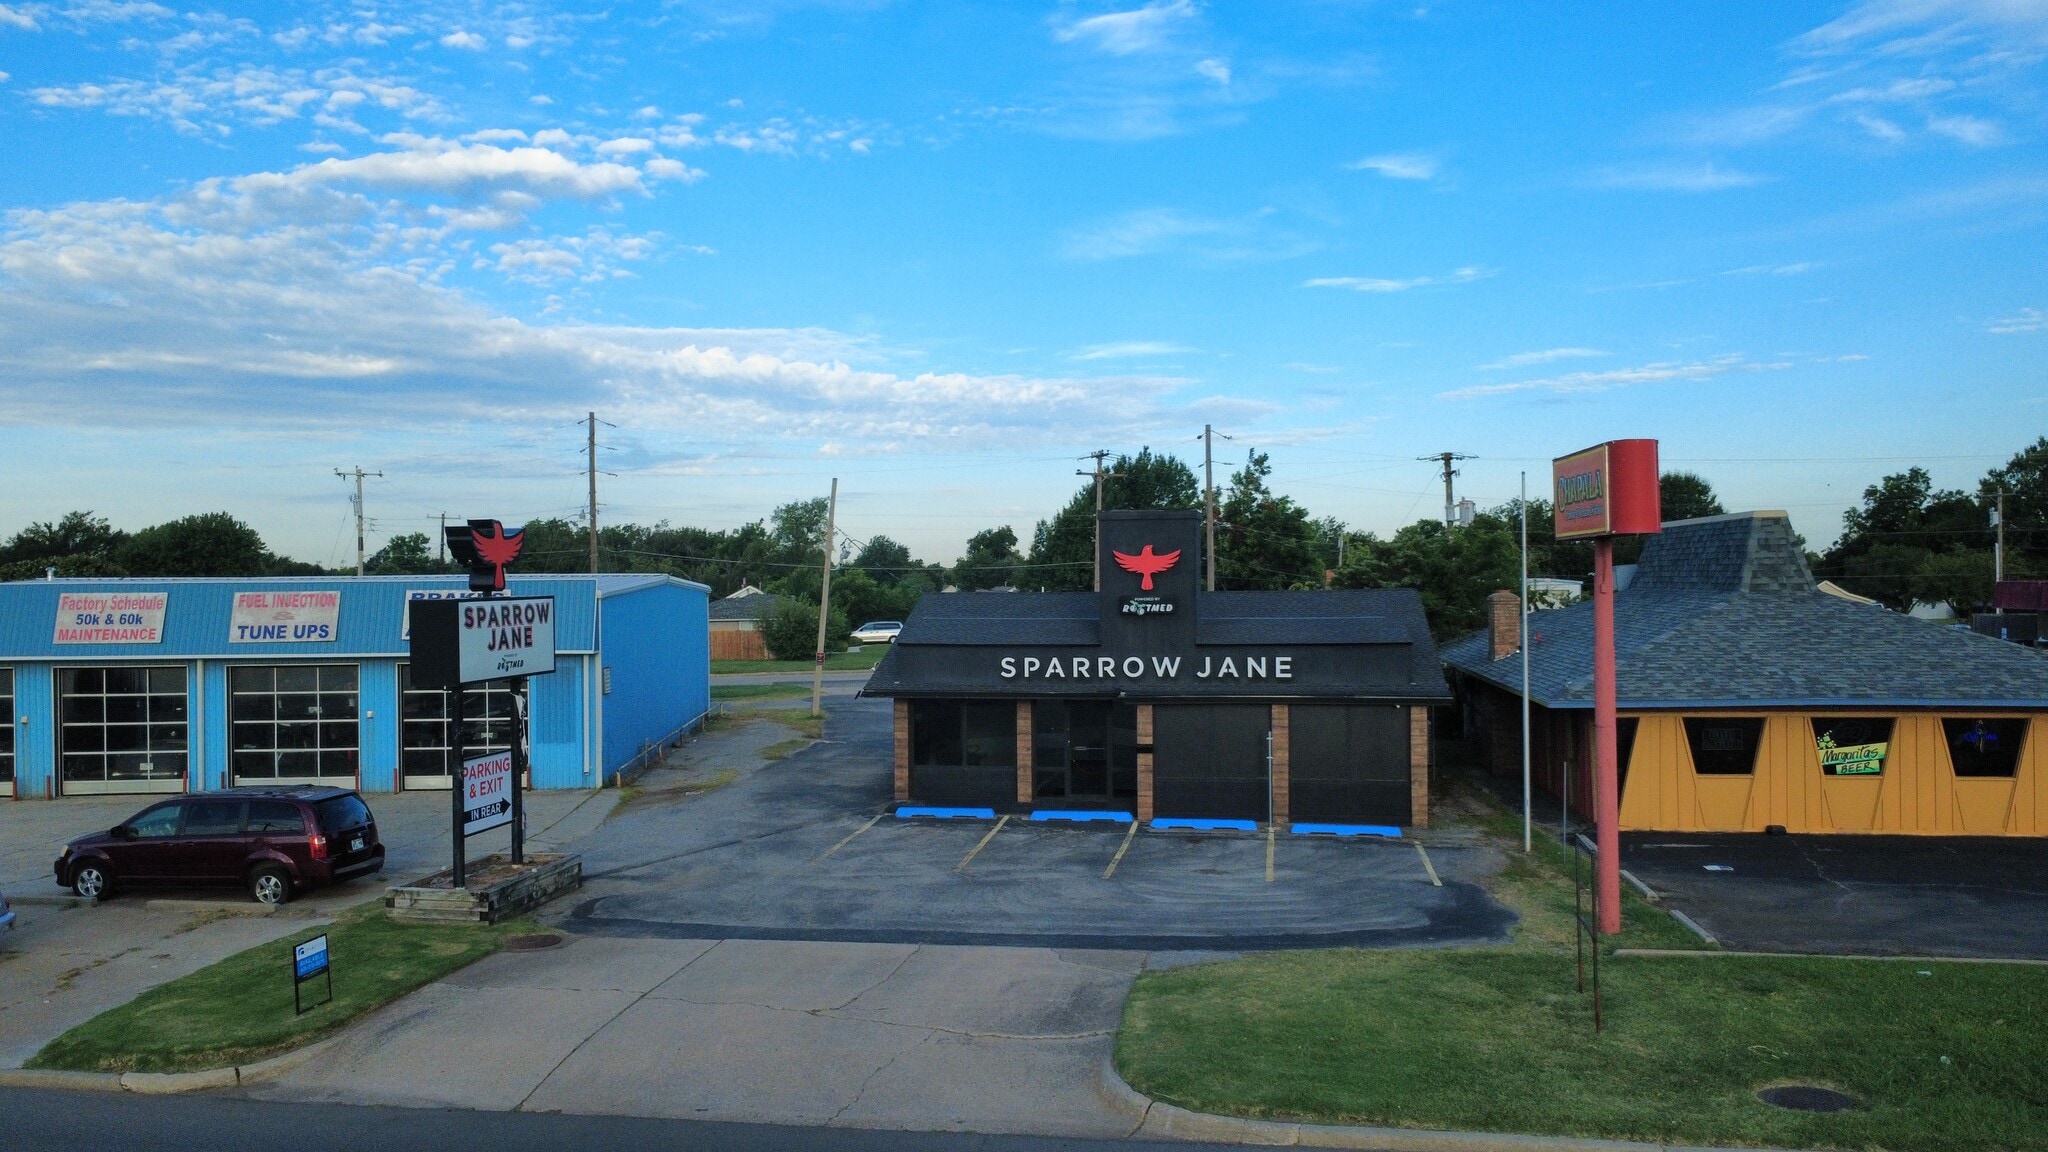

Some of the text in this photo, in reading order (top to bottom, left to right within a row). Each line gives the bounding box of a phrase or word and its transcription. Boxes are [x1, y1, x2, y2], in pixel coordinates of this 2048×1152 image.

[1557, 469, 1603, 513] CHAPALA
[61, 595, 164, 614] Factory Schedule
[238, 593, 338, 608] FUEL INJECTION
[76, 614, 143, 625] 50k & 60k
[464, 602, 550, 629] SPARROW
[58, 628, 157, 641] MAINTENANCE
[237, 625, 330, 639] TUNE UPS
[487, 626, 533, 652] JANE
[1000, 656, 1293, 678] SPARROW JANE
[1822, 746, 1878, 764] Margaritas
[463, 756, 511, 781] PARKING
[1841, 762, 1875, 774] BEER
[469, 776, 503, 799] & EXIT
[471, 803, 501, 821] IN REAR
